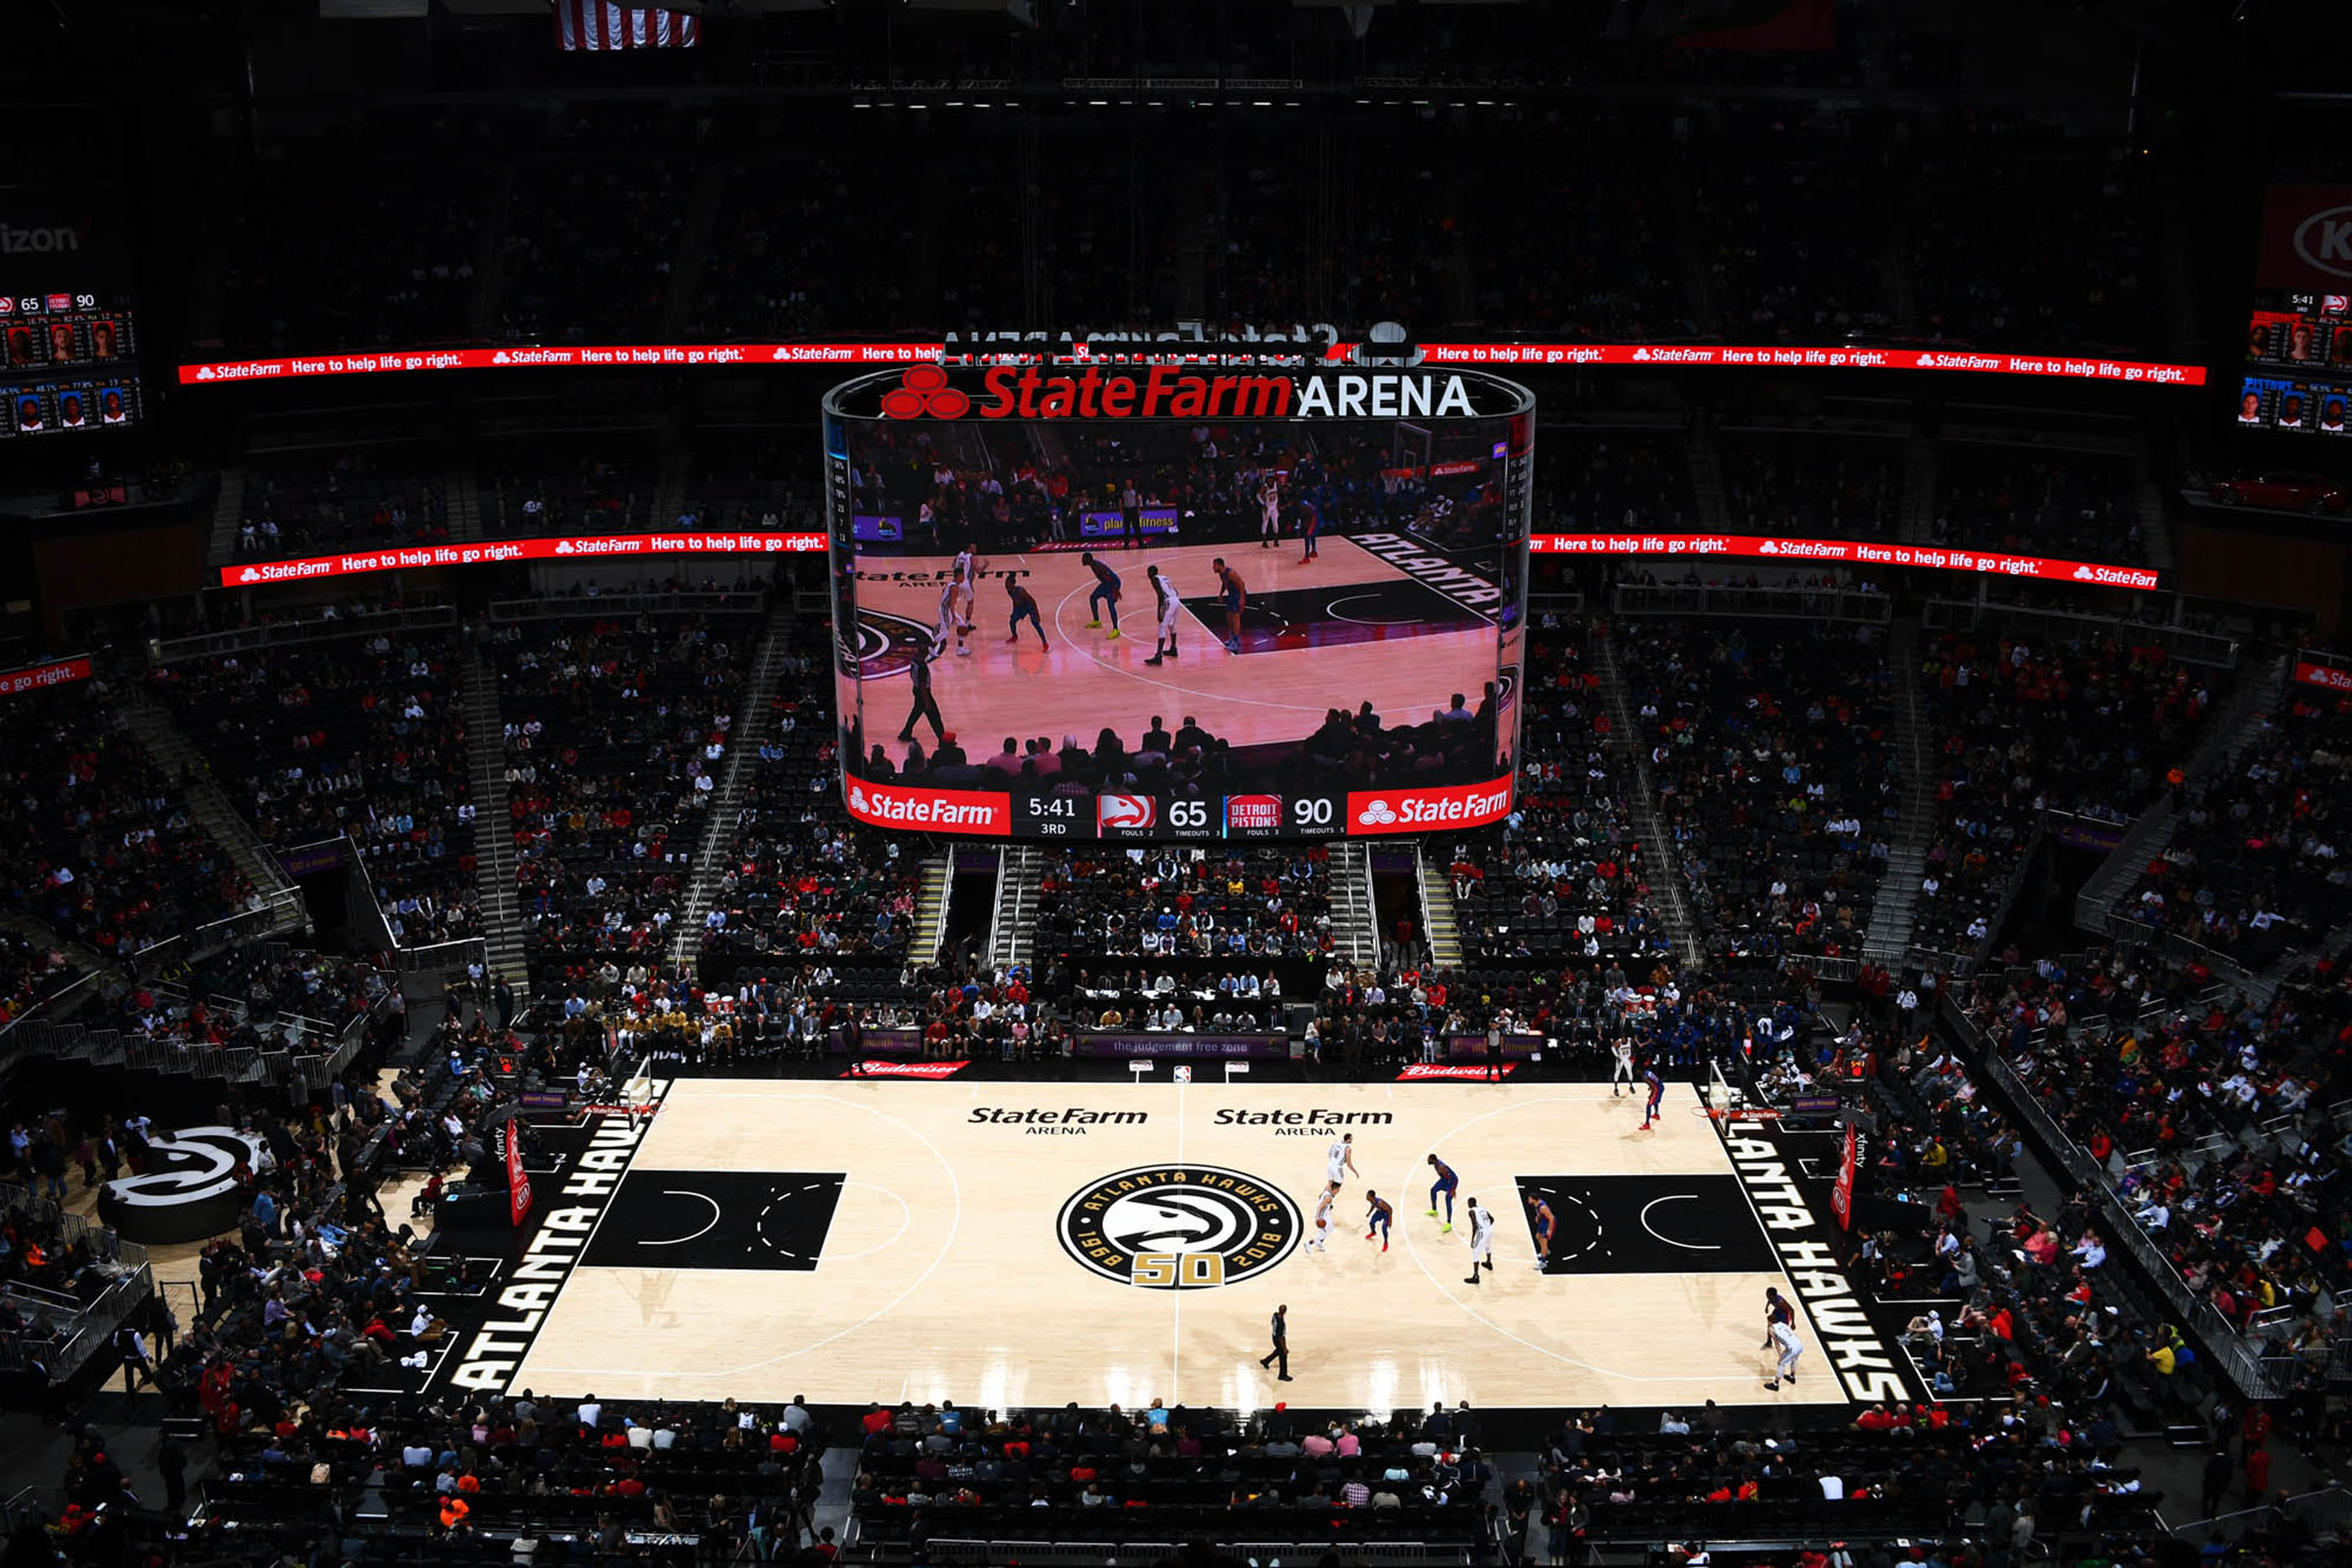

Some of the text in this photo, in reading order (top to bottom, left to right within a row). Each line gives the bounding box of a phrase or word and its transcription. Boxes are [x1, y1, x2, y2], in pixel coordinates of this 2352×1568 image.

[21, 297, 39, 311] 65
[76, 294, 94, 307] 90
[2292, 294, 2313, 304] 5:41
[512, 348, 743, 364] StateFarm Here to help life go right.
[792, 347, 852, 360] StateFarm
[863, 348, 894, 359] Here
[898, 348, 911, 359] to
[1437, 348, 1469, 359] Here
[1473, 349, 1486, 359] to
[1490, 347, 1518, 361] help
[1522, 347, 1542, 359] life
[1547, 350, 1563, 362] go
[1567, 348, 1604, 362] right.
[1651, 348, 1887, 366] StateFarm Here to help life go right.
[217, 354, 461, 378] StateFarm Here to help life go right.
[1936, 354, 2185, 383] StateFarm Here to help life go right.
[979, 364, 1473, 418] StateFarm ARENA
[575, 536, 824, 553] StateFarm Here to help life go right.
[1554, 538, 1587, 550] Here
[1591, 539, 1605, 550] to
[1609, 538, 1638, 553] help
[1643, 538, 1664, 550] life
[1668, 541, 1685, 553] go
[1690, 538, 1727, 553] right.
[261, 544, 522, 579] StateFarm Here to help life go right.
[1780, 540, 2040, 574] StateFarm Here to help life go right.
[1350, 533, 1501, 604] ATLANTA
[13, 676, 32, 691] go
[36, 666, 76, 684] right.
[870, 794, 992, 825] StateFarm
[1029, 798, 1075, 816] 5:41
[1169, 800, 1207, 826] 65
[1231, 804, 1277, 815] DETROIT
[1294, 798, 1332, 825] 90
[1398, 789, 1507, 822] StateFarm
[1042, 823, 1066, 834] 3RD
[1231, 815, 1278, 827] PISTONS
[1114, 1041, 1247, 1052] the judgement free zone
[852, 1062, 958, 1074] Budweiser
[968, 1107, 1148, 1125] StateFarm
[1213, 1109, 1393, 1125] StateFarm
[1025, 1126, 1087, 1135] ARENA
[1274, 1127, 1336, 1135] ARENA
[494, 1127, 508, 1162] xfinity
[1854, 1133, 1868, 1168] xfinity
[1083, 1172, 1279, 1214] ATLANTA HAWKS
[450, 1078, 669, 1392] ATLANTA HAWS
[1698, 1083, 1912, 1402] LANTA HAWKS
[1076, 1230, 1125, 1267] 1968
[1231, 1230, 1283, 1267] 2018
[1131, 1251, 1226, 1286] 50
